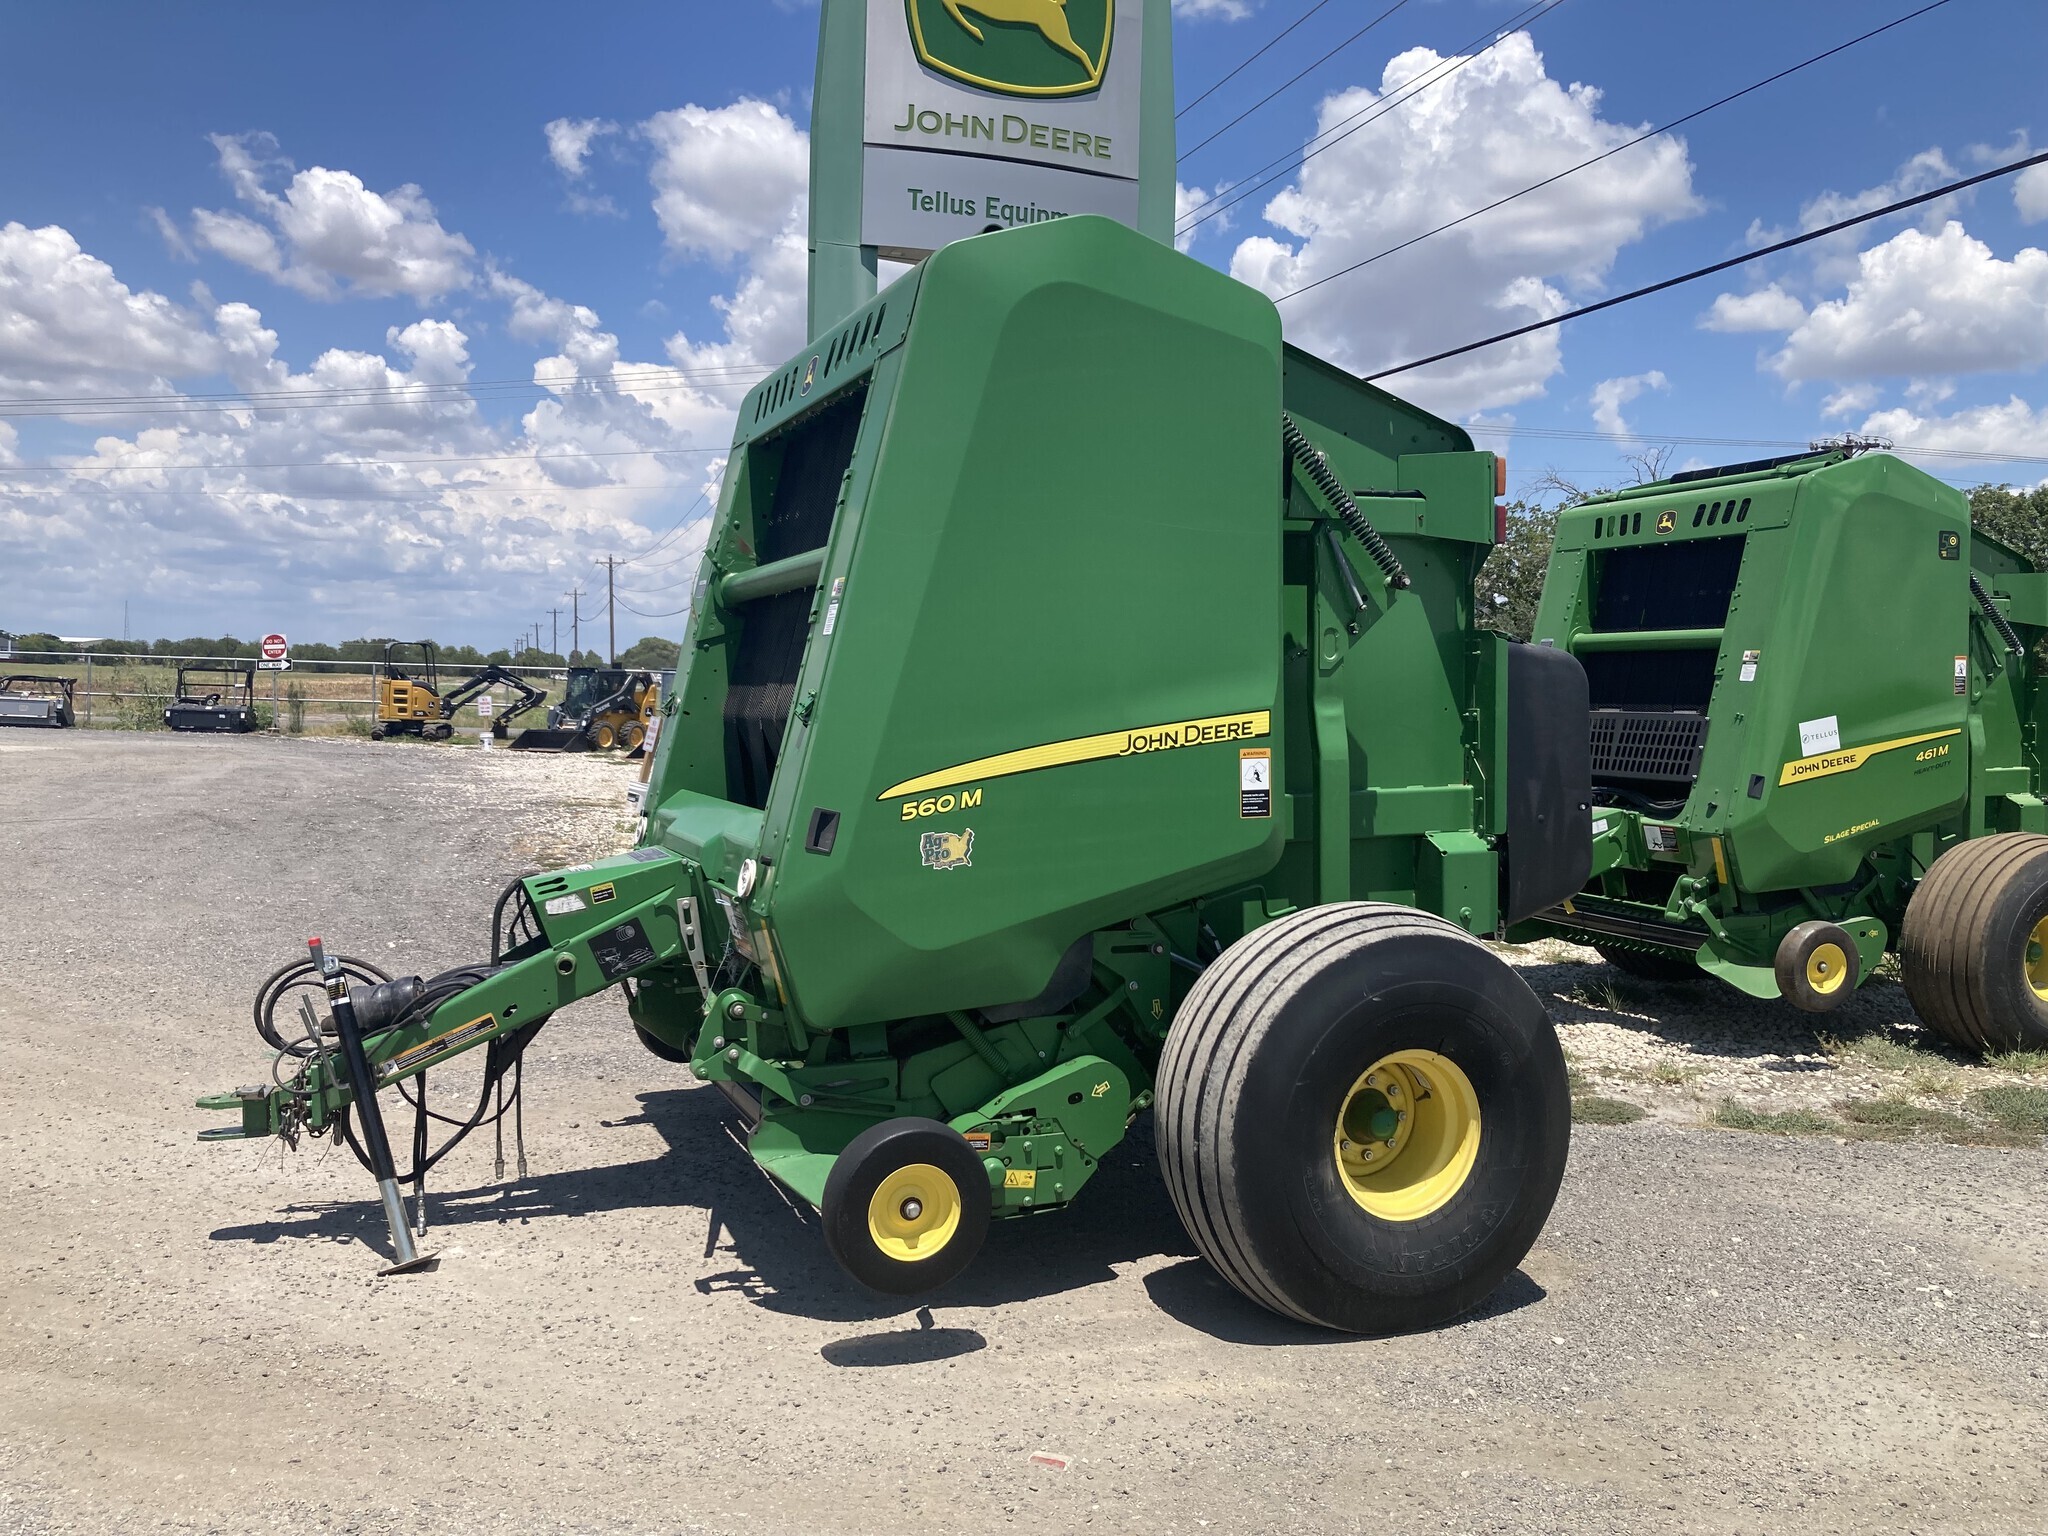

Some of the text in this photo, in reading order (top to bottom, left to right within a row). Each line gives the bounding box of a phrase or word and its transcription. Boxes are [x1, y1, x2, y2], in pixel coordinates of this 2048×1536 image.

[894, 103, 1112, 160] JOHN DEERE
[907, 187, 976, 217] Tellus
[1119, 720, 1253, 754] JOHN DEERE
[1811, 729, 1838, 741] TELLUS
[1791, 754, 1857, 776] JOHN DEERE
[1915, 744, 1949, 762] 461 M
[901, 788, 983, 821] 560 M
[1823, 818, 1880, 844] SILAGE SPECIAL
[924, 848, 950, 862] Pro
